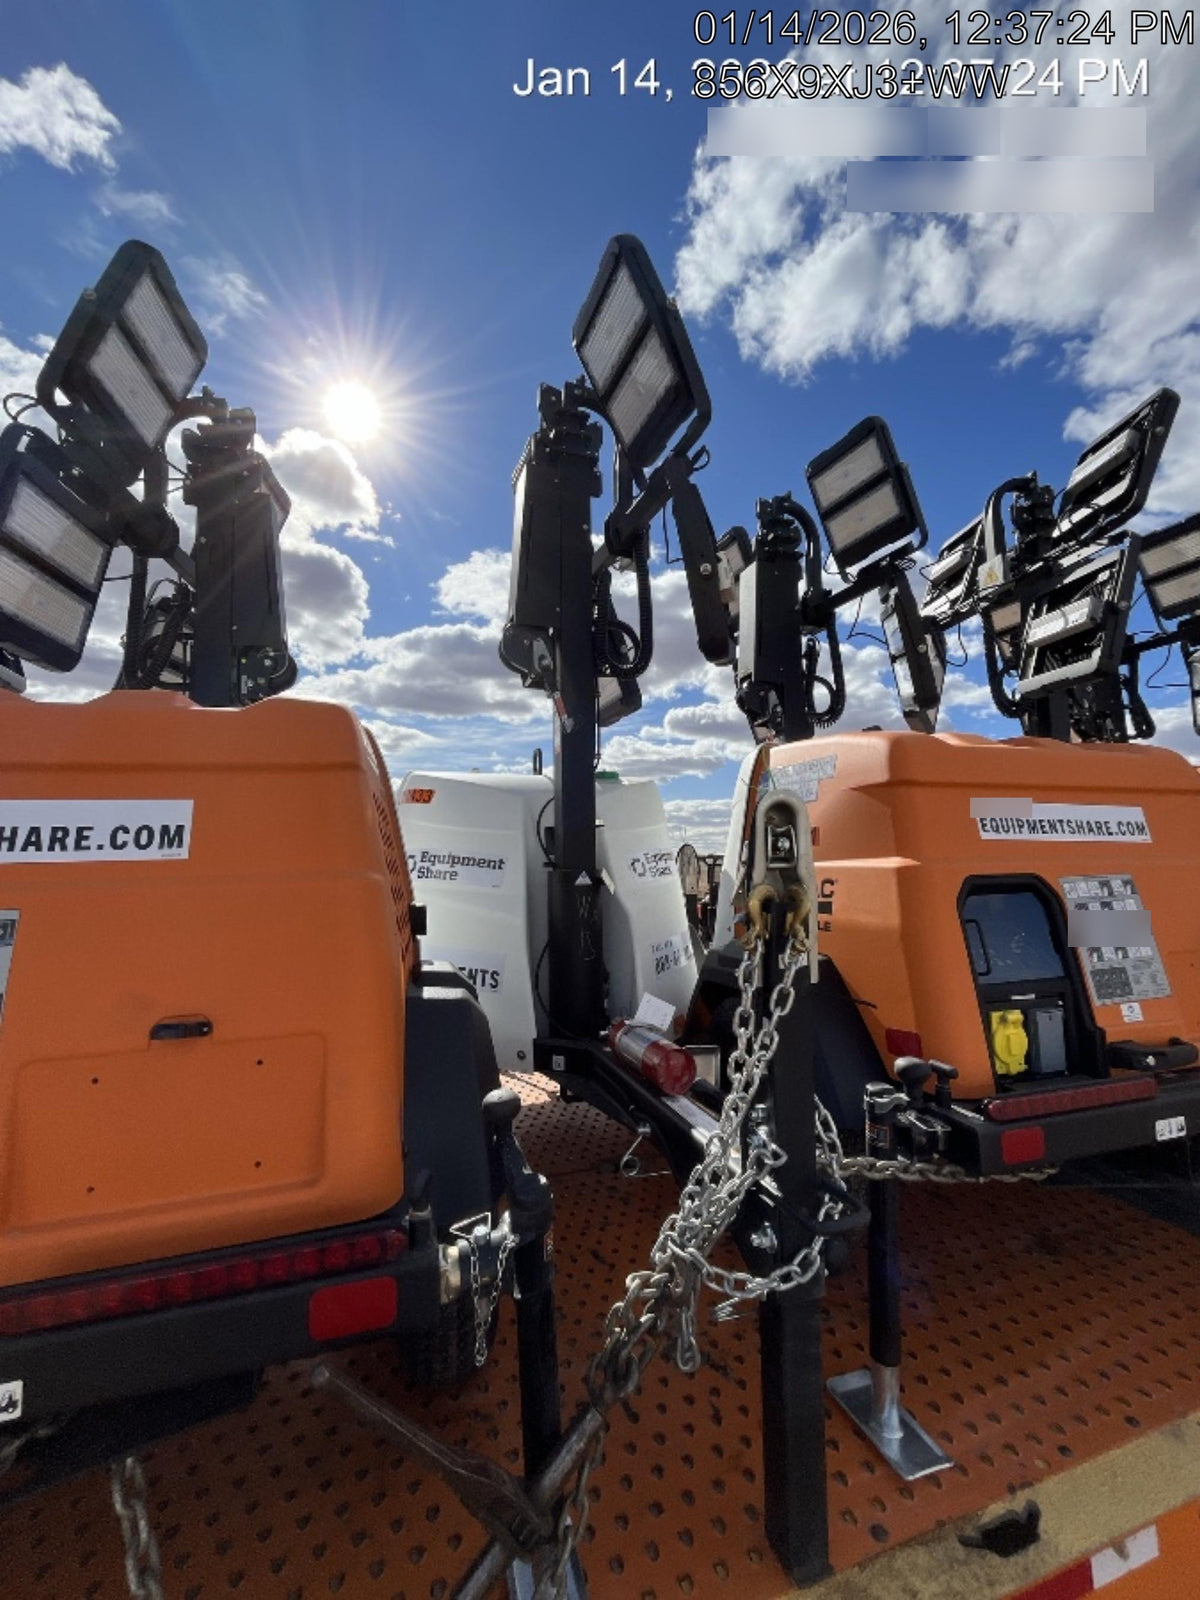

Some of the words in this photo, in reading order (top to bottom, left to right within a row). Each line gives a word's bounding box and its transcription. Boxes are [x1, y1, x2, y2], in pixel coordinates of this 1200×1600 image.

[979, 817, 1149, 837] EQUIPMENTSHARE.COM
[0, 824, 186, 853] HARE.COM
[420, 850, 506, 871] Equipment
[417, 865, 459, 881] Share
